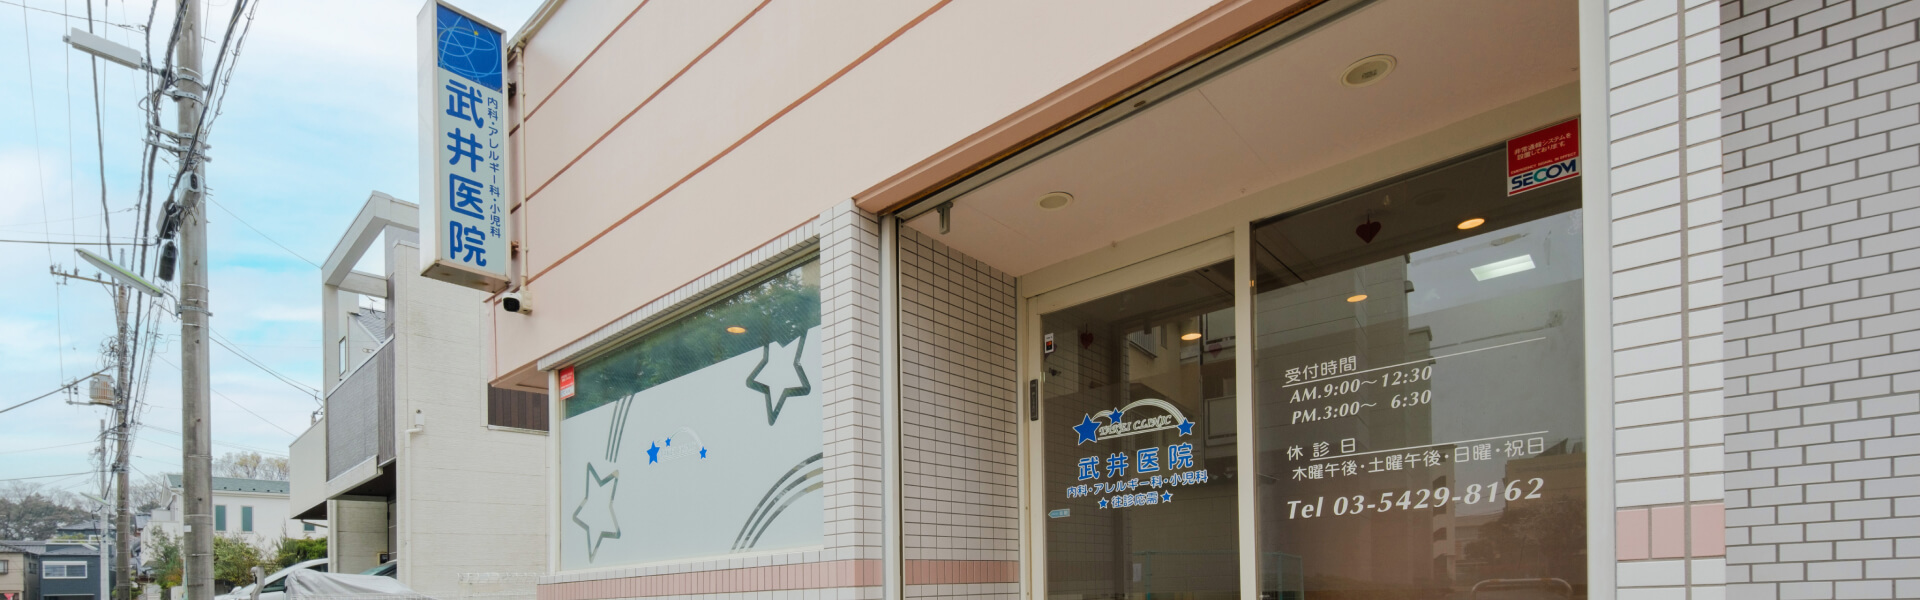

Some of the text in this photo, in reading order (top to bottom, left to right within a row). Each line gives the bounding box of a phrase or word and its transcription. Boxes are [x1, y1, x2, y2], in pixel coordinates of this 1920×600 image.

[446, 78, 487, 268] 武井医院
[487, 96, 501, 239] 内科・アレルギー科・小児科
[1511, 159, 1577, 190] SECOM
[1284, 355, 1357, 385] 受付時間
[1078, 442, 1194, 482] 武井医院
[1287, 476, 1545, 520] Tel 03-5429-8162
